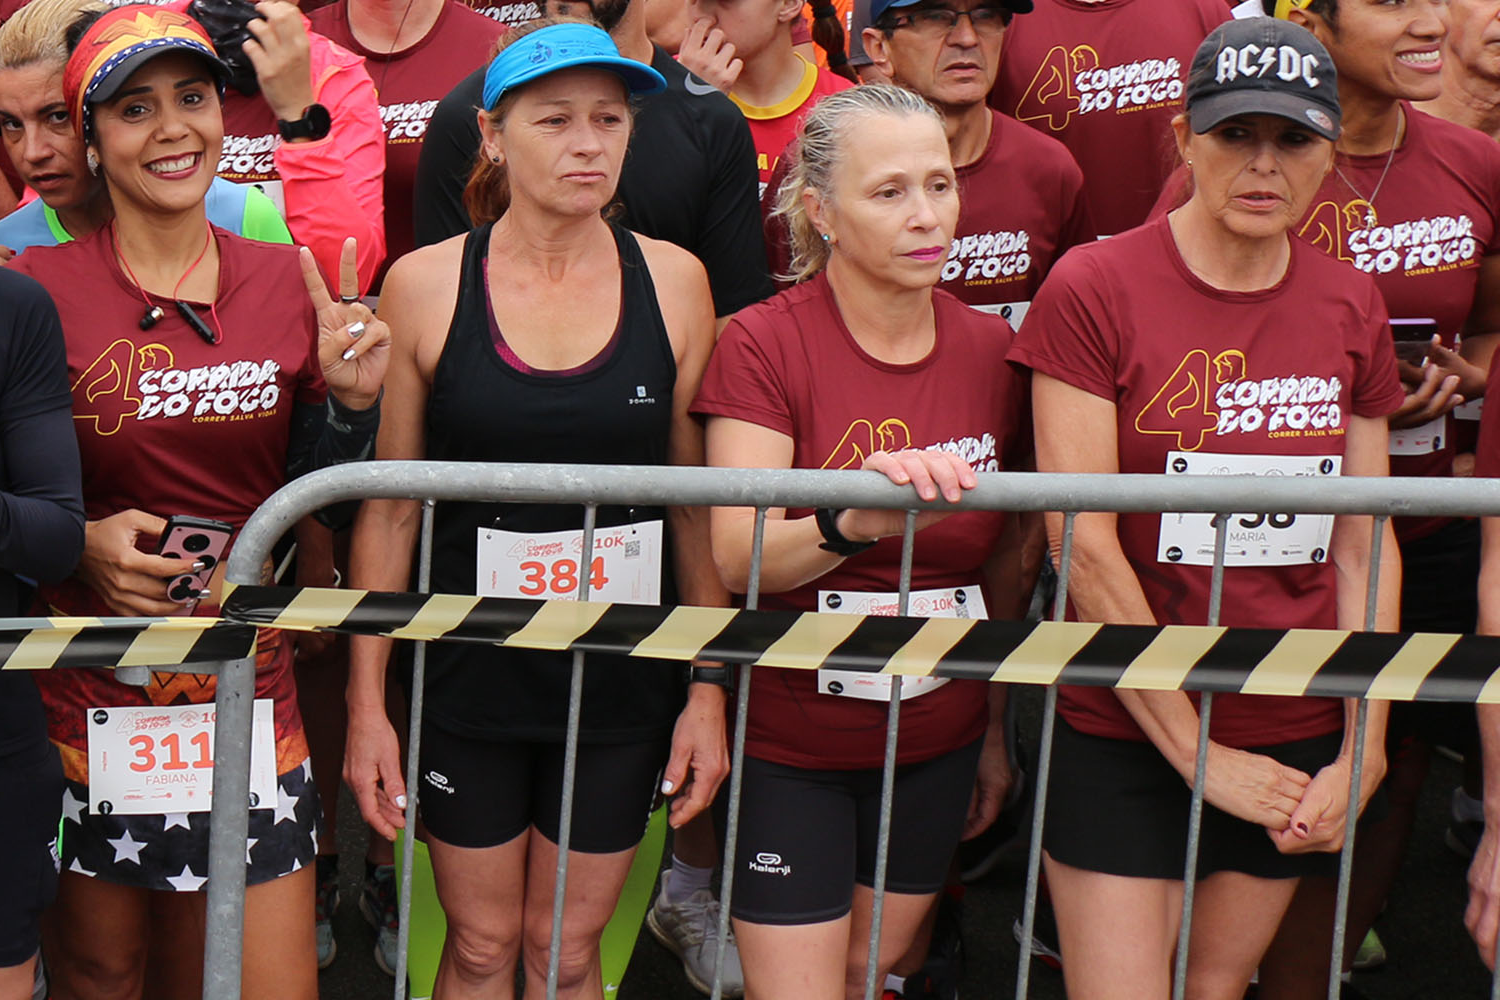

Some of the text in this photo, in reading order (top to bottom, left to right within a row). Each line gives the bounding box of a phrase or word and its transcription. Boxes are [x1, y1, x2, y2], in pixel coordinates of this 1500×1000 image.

[1075, 58, 1180, 92] CORRIDA
[1116, 79, 1183, 108] FOGO
[1348, 215, 1473, 253] CORRIDA
[1404, 238, 1476, 270] FOGO
[137, 358, 281, 395] CORRIDA
[1215, 374, 1342, 408] CORRIDA
[137, 384, 281, 420] DO FOGO
[192, 414, 225, 423] CORRER
[230, 412, 254, 422] SALVA
[1216, 401, 1342, 436] DO FOGO
[1268, 429, 1300, 438] CORRER
[1304, 429, 1325, 437] SALVA
[594, 535, 626, 549] 10K
[1229, 531, 1267, 542] MARIA
[519, 557, 609, 596] 384
[932, 598, 955, 611] 10K
[129, 731, 215, 773] 311
[146, 773, 197, 785] FABIANA
[749, 861, 791, 876] Kalenji
